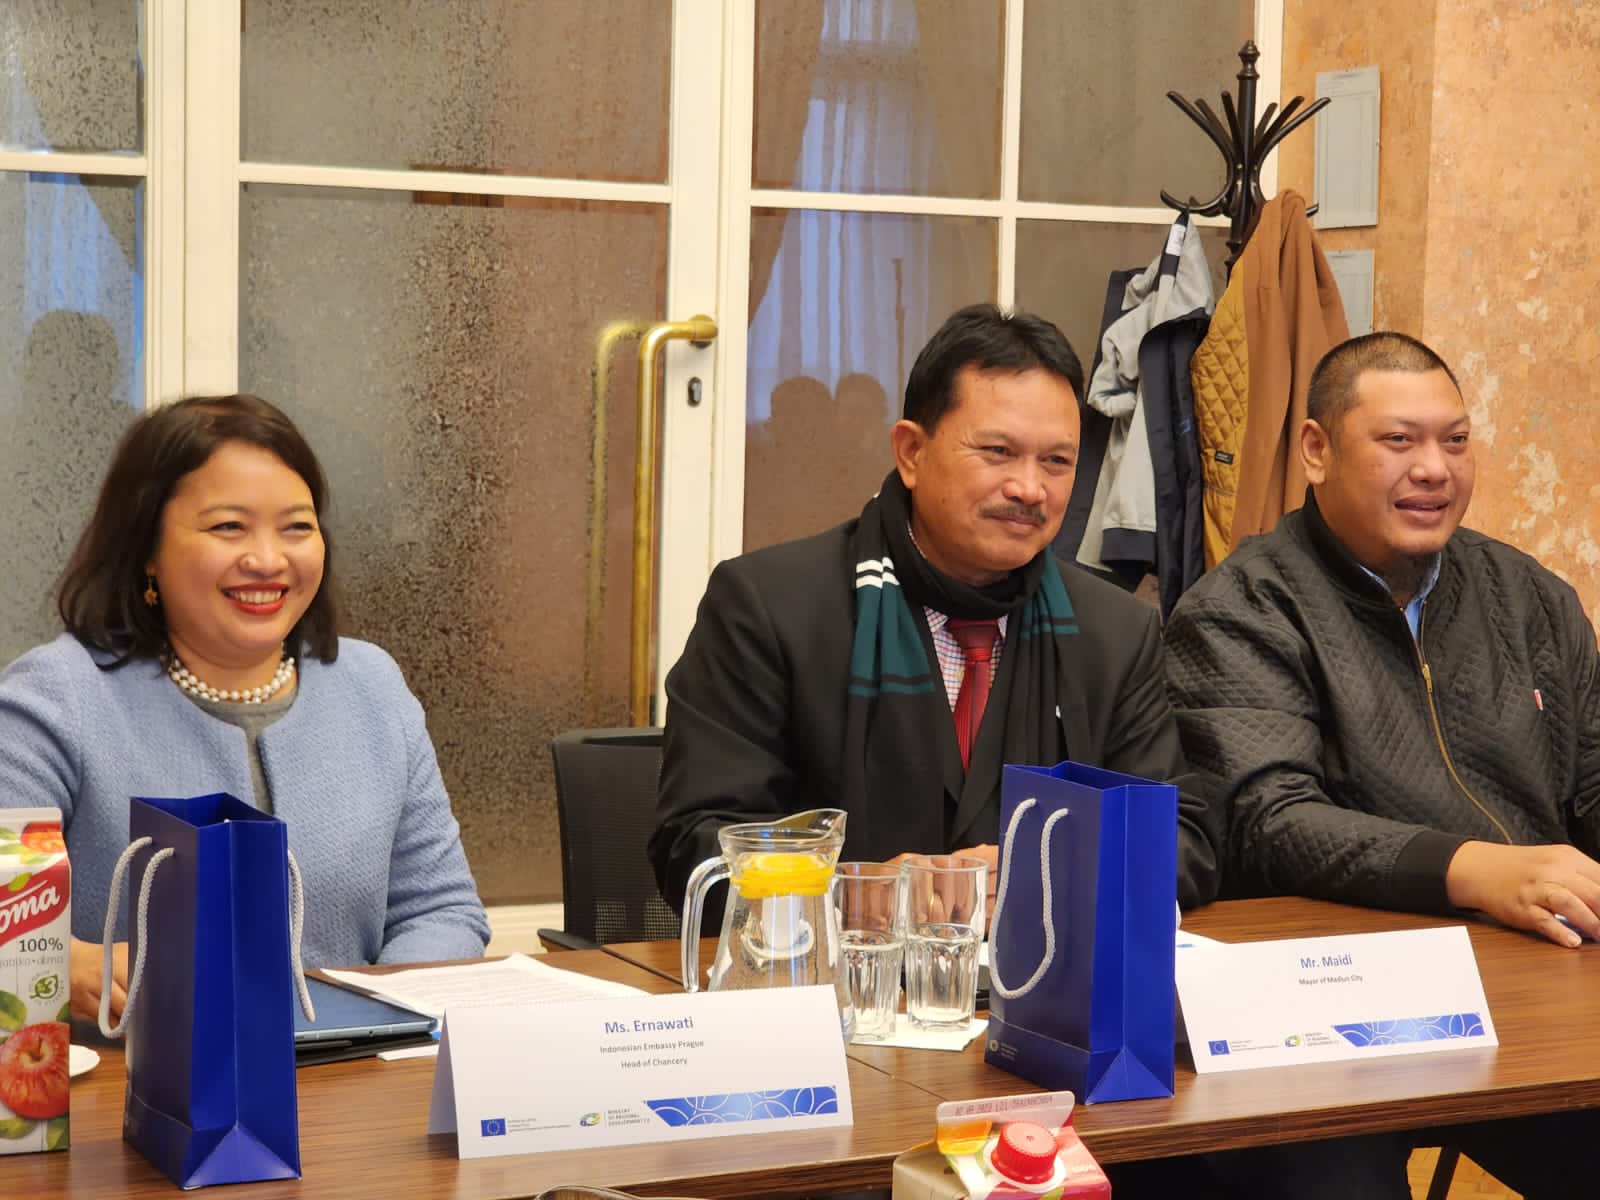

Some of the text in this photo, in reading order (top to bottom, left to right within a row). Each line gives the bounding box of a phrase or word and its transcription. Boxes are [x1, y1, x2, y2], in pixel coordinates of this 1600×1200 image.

[0, 885, 60, 934] oma
[19, 937, 63, 953] 100%
[1300, 953, 1353, 968] Mr. Maidi
[1351, 974, 1363, 982] City
[605, 1016, 694, 1034] Ms. Ernawati
[600, 1040, 704, 1053] Indonesian Embassy Prague
[621, 1057, 688, 1068] Head of Chancery
